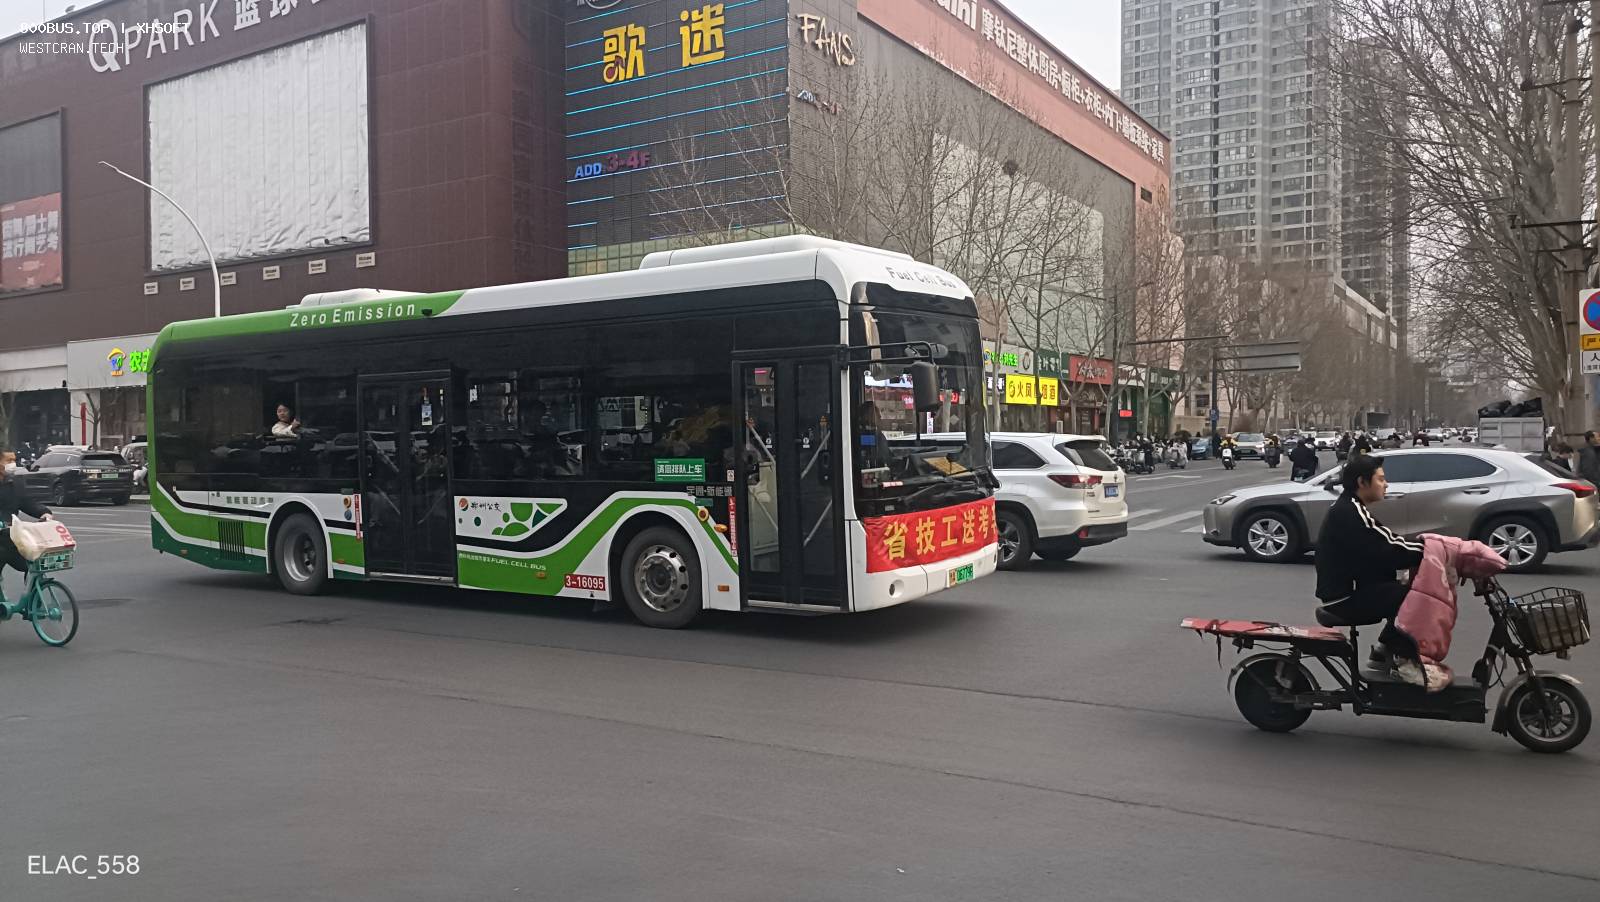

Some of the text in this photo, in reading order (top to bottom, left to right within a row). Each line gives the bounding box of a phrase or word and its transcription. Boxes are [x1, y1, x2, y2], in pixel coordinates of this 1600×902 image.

[602, 3, 725, 83] 歌迷
[796, 13, 855, 67] FANS
[290, 303, 416, 328] Zero Emission
[491, 557, 509, 566] FUEL
[511, 560, 529, 568] CELL
[530, 563, 547, 571] BUS
[565, 574, 605, 590] 3-16095
